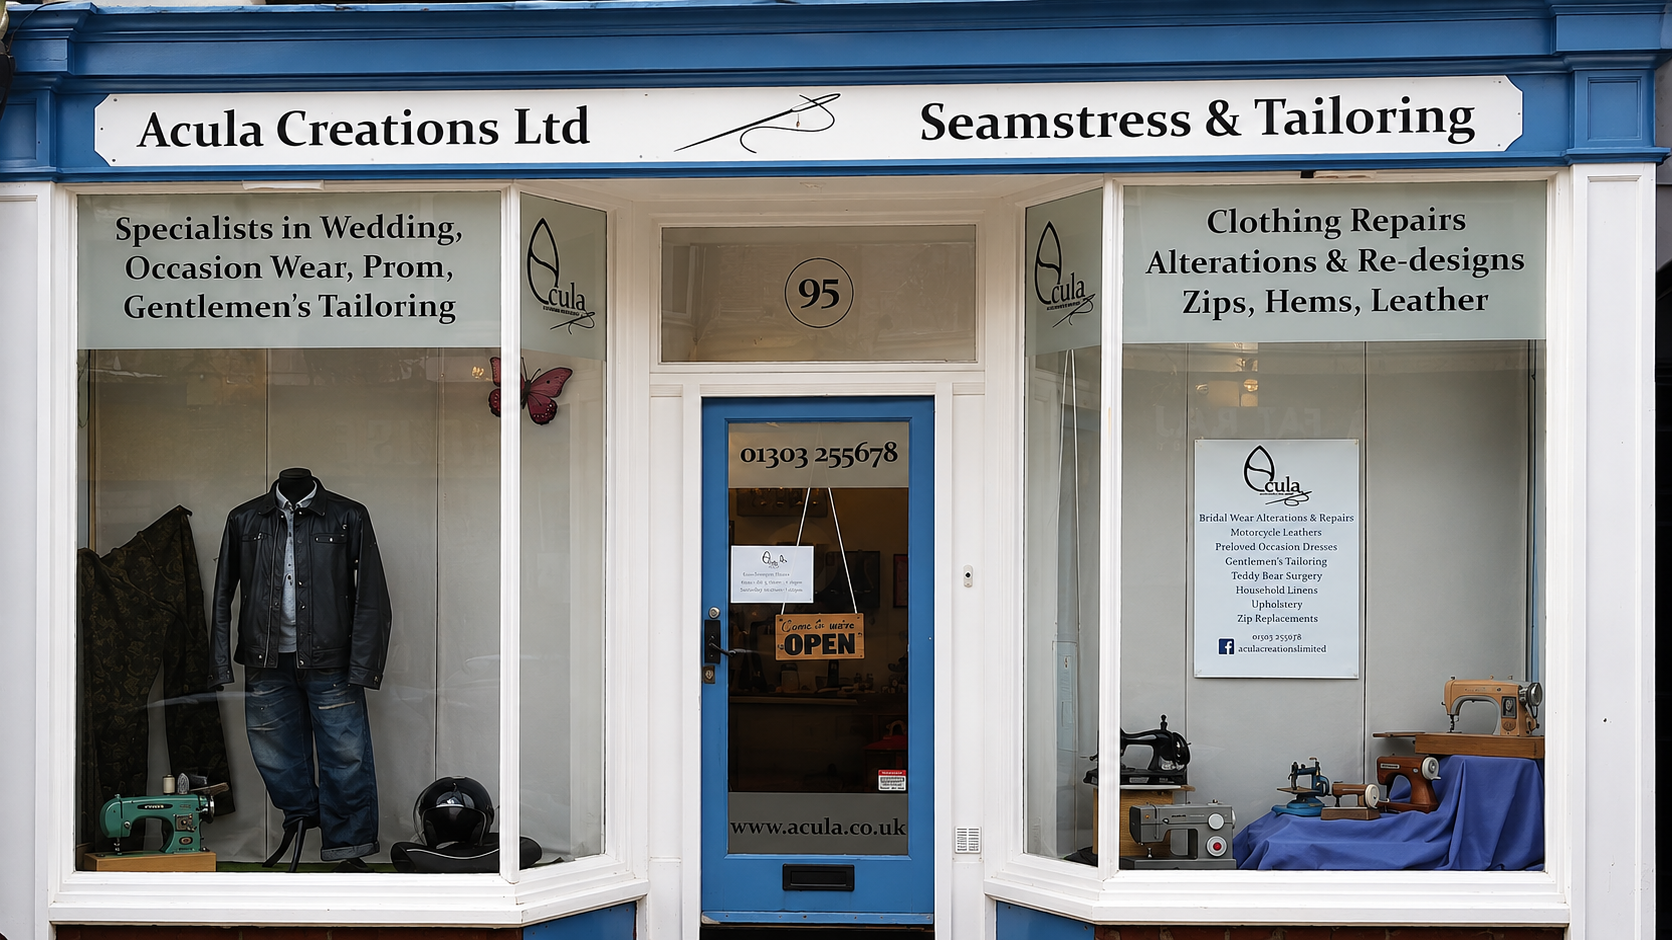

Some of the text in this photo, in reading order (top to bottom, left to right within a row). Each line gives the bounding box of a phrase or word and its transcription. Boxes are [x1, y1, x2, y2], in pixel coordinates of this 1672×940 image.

[137, 105, 590, 147] Acula Creations Ltd
[921, 95, 1475, 144] Seamstress & Tailoring
[116, 213, 463, 247] Specialists in Wedding,
[1207, 206, 1466, 240] Clothing Repairs
[125, 254, 453, 283] Occasion Wear, Prom,
[527, 217, 586, 310] Acula
[1034, 220, 1086, 305] Acula
[1145, 246, 1525, 279] Alterations & Re-designs
[124, 292, 456, 325] Gentlemen's Tailoring
[798, 279, 842, 310] 95
[1182, 286, 1489, 320] Zips, Hems, Leather
[740, 441, 898, 469] 01303 255678
[1244, 445, 1301, 493] Acula
[1199, 513, 1355, 524] Bridal Wear Alterations & Repairs
[1215, 542, 1338, 551] Preloved Occasion Dresses
[1230, 528, 1322, 538] Motorcycle Leathers
[1225, 557, 1328, 567] Gentlemen's Tailoring
[1231, 571, 1260, 582] Teddy
[1285, 571, 1323, 582] Surgery
[1236, 586, 1318, 595] Household Linens
[1251, 599, 1303, 611] Upholstery
[1237, 614, 1319, 625] Zip Replacements
[784, 633, 856, 656] OPEN
[1238, 644, 1327, 653] aculacreationslimited
[730, 817, 907, 836] www.acula.co.uk
